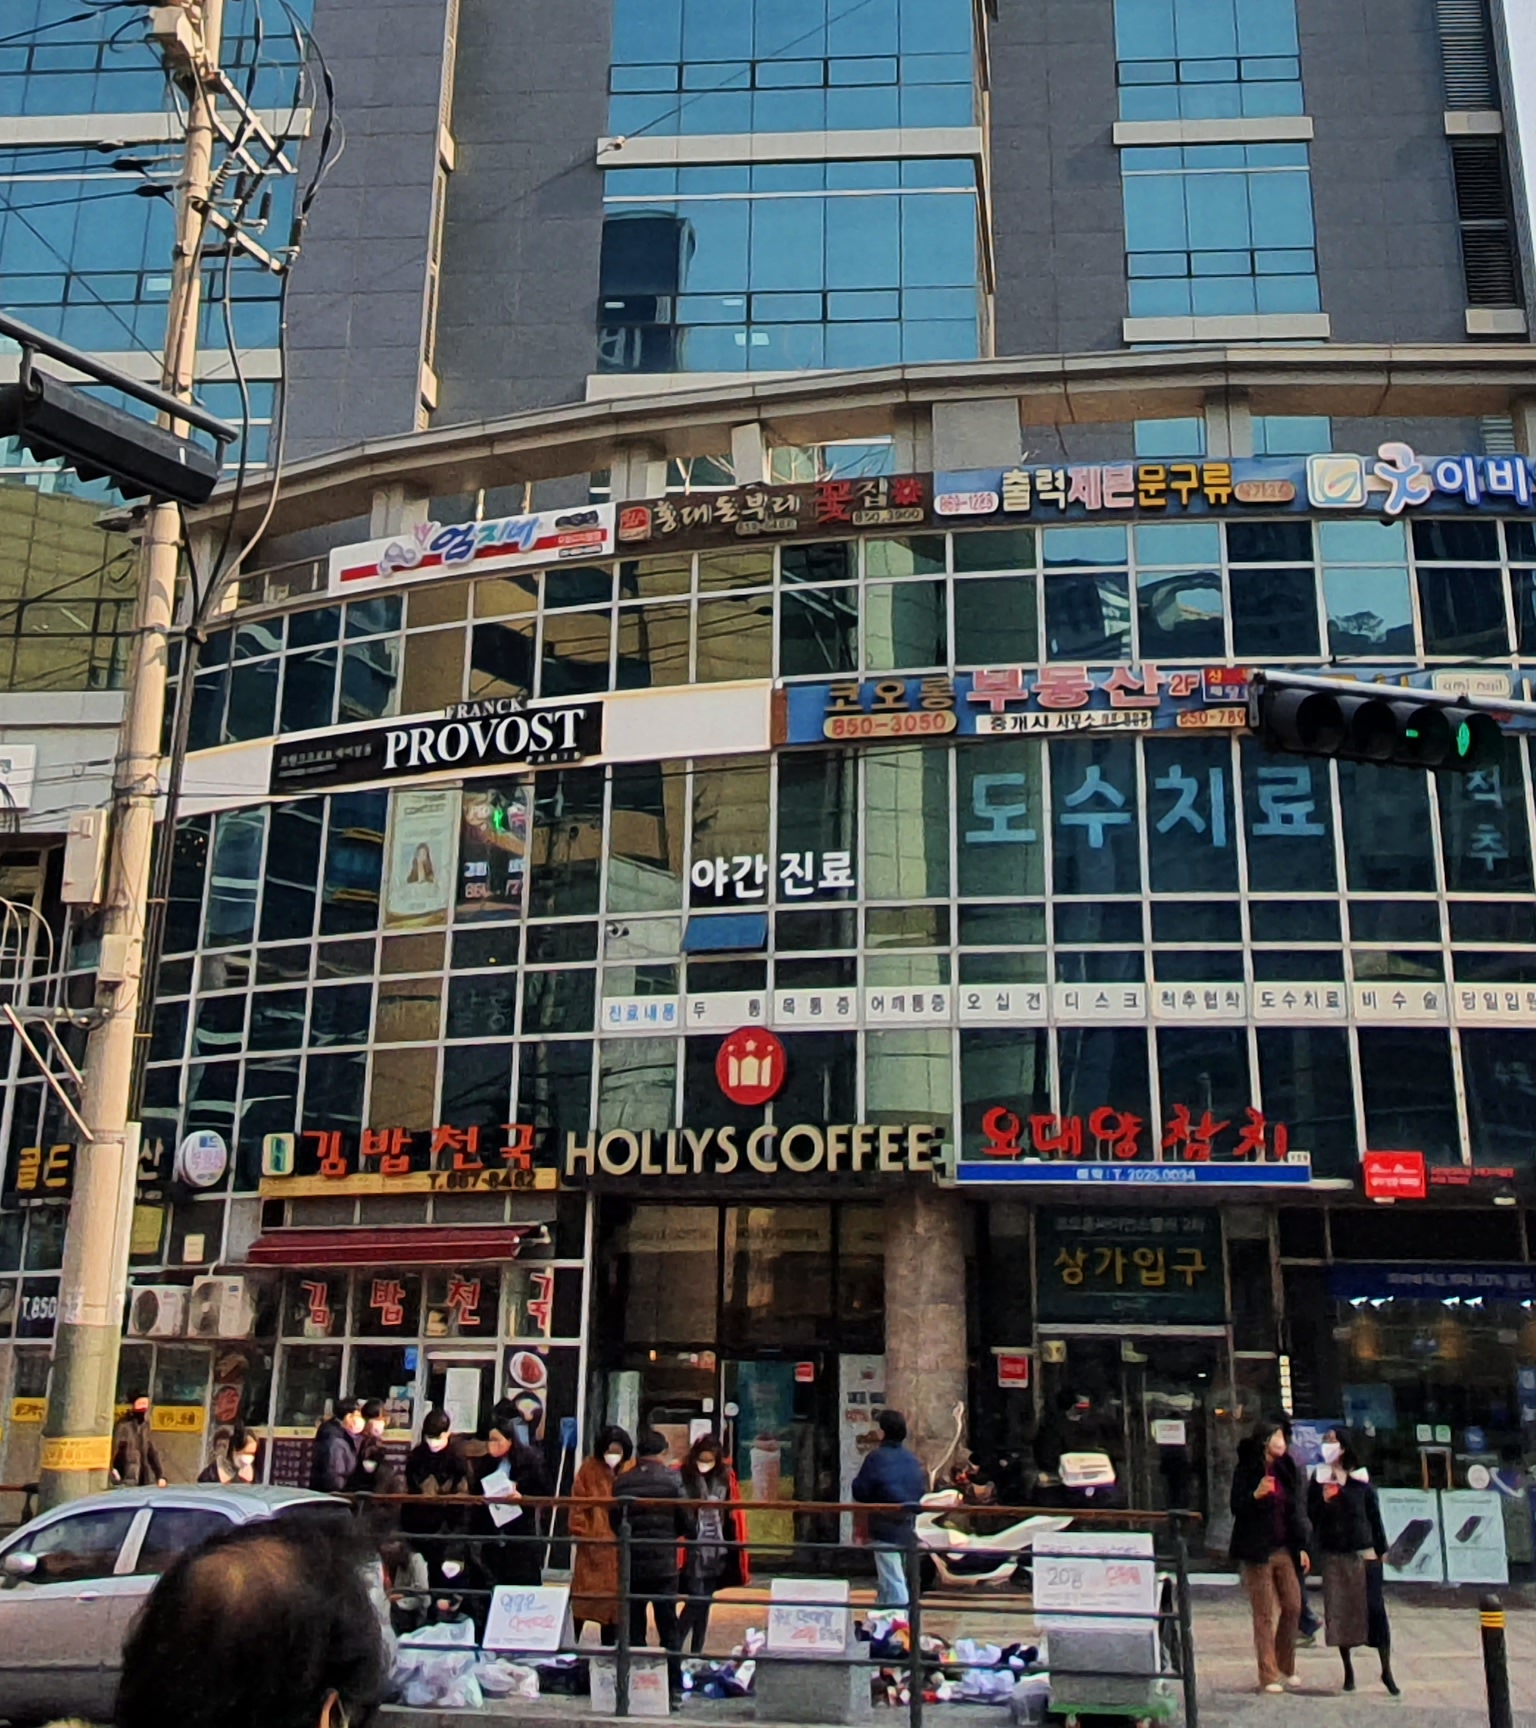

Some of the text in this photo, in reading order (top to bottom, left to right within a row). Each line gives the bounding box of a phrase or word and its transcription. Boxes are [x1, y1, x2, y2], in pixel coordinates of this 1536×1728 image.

[1002, 463, 1233, 512] 출력 제본 문구류
[444, 696, 524, 719] FRANCK
[825, 676, 955, 713] 코오롱
[966, 665, 1166, 713] 부동산
[1168, 672, 1200, 696] 2F
[382, 708, 586, 771] PROVOST
[830, 712, 948, 738] 850-3050
[965, 763, 1326, 849] 도수치료
[690, 849, 857, 898] 야간진료
[608, 1002, 677, 1025] 진료내용
[780, 994, 851, 1017] 목통증
[869, 992, 946, 1015] 어깨통증
[965, 990, 1043, 1014] 오십견
[1064, 990, 1141, 1011] 디스크
[1160, 989, 1241, 1012] 척추협착
[1260, 988, 1341, 1011] 도수치료
[1362, 989, 1440, 1013] 비수술
[301, 1123, 537, 1179] 김밥천국
[565, 1123, 938, 1178] HOLLYS COFFEE
[979, 1102, 1290, 1162] 오대양 참치
[1052, 1245, 1207, 1289] 상가입구
[301, 1272, 553, 1329] 김밥천국
